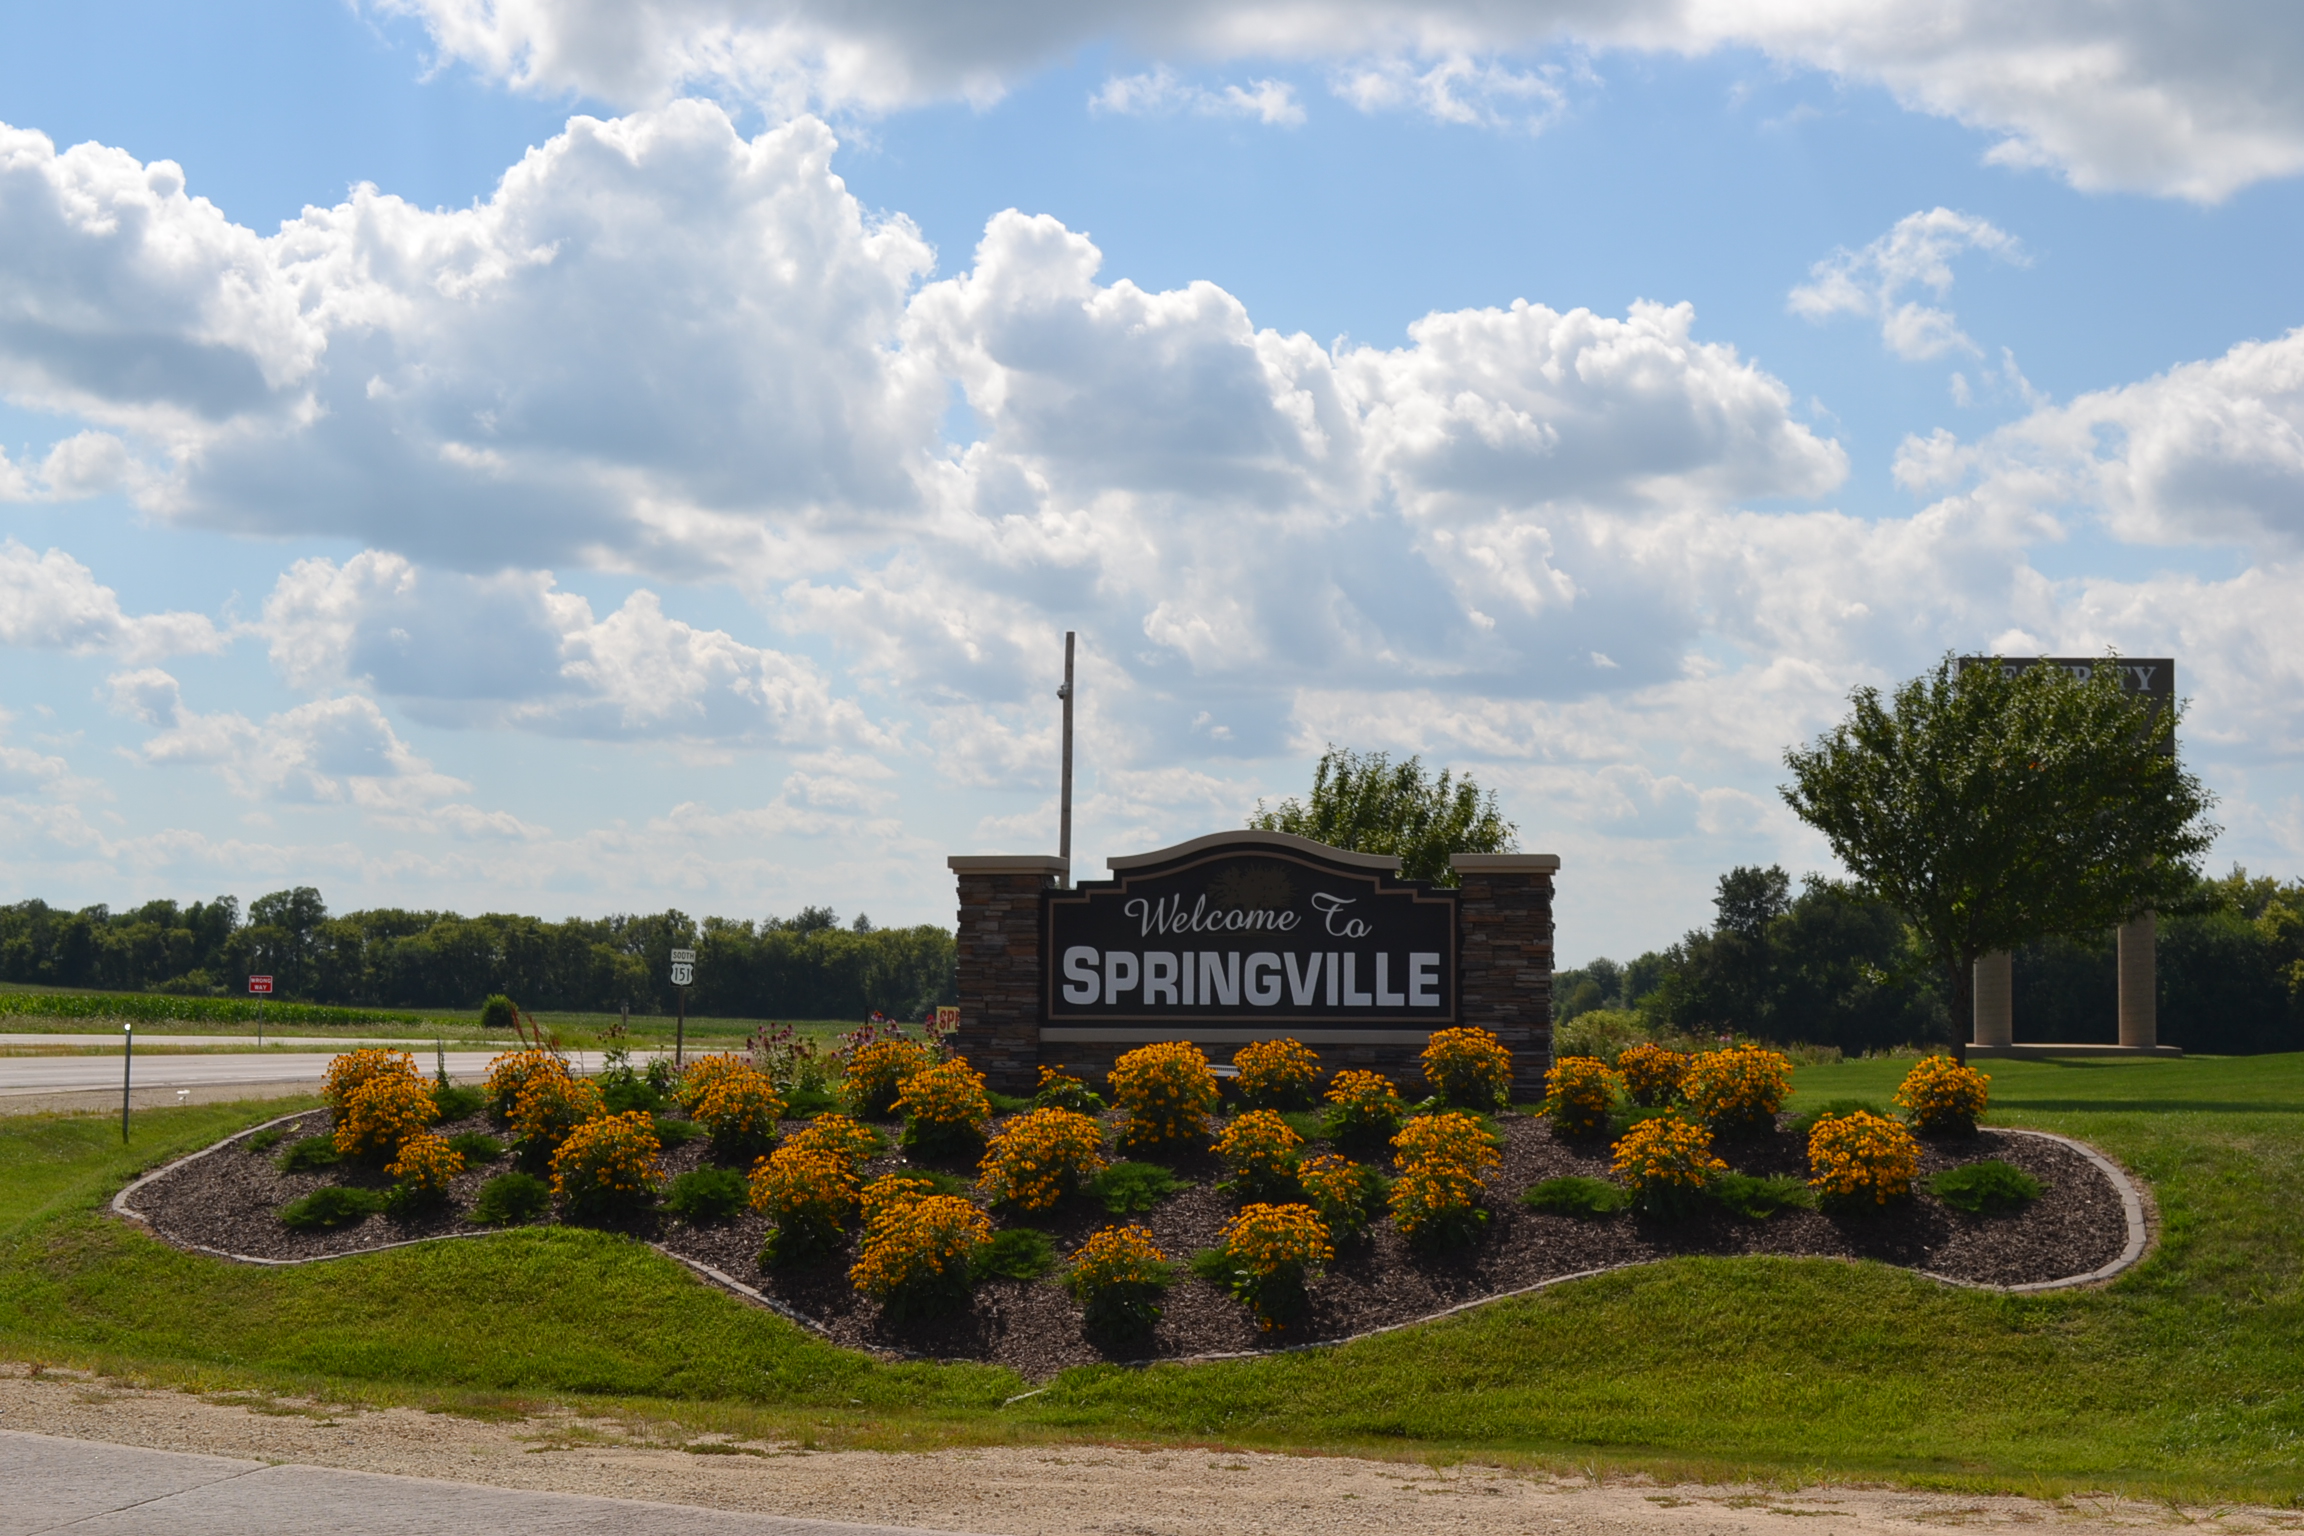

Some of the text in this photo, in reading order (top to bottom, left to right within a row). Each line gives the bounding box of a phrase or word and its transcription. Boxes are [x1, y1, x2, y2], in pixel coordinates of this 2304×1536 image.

[1980, 665, 2157, 691] ERTY
[1123, 892, 1373, 938] Welcome To
[673, 951, 694, 960] SOUTH
[675, 967, 690, 981] 151
[1062, 945, 1441, 1007] SPRINGVILLE
